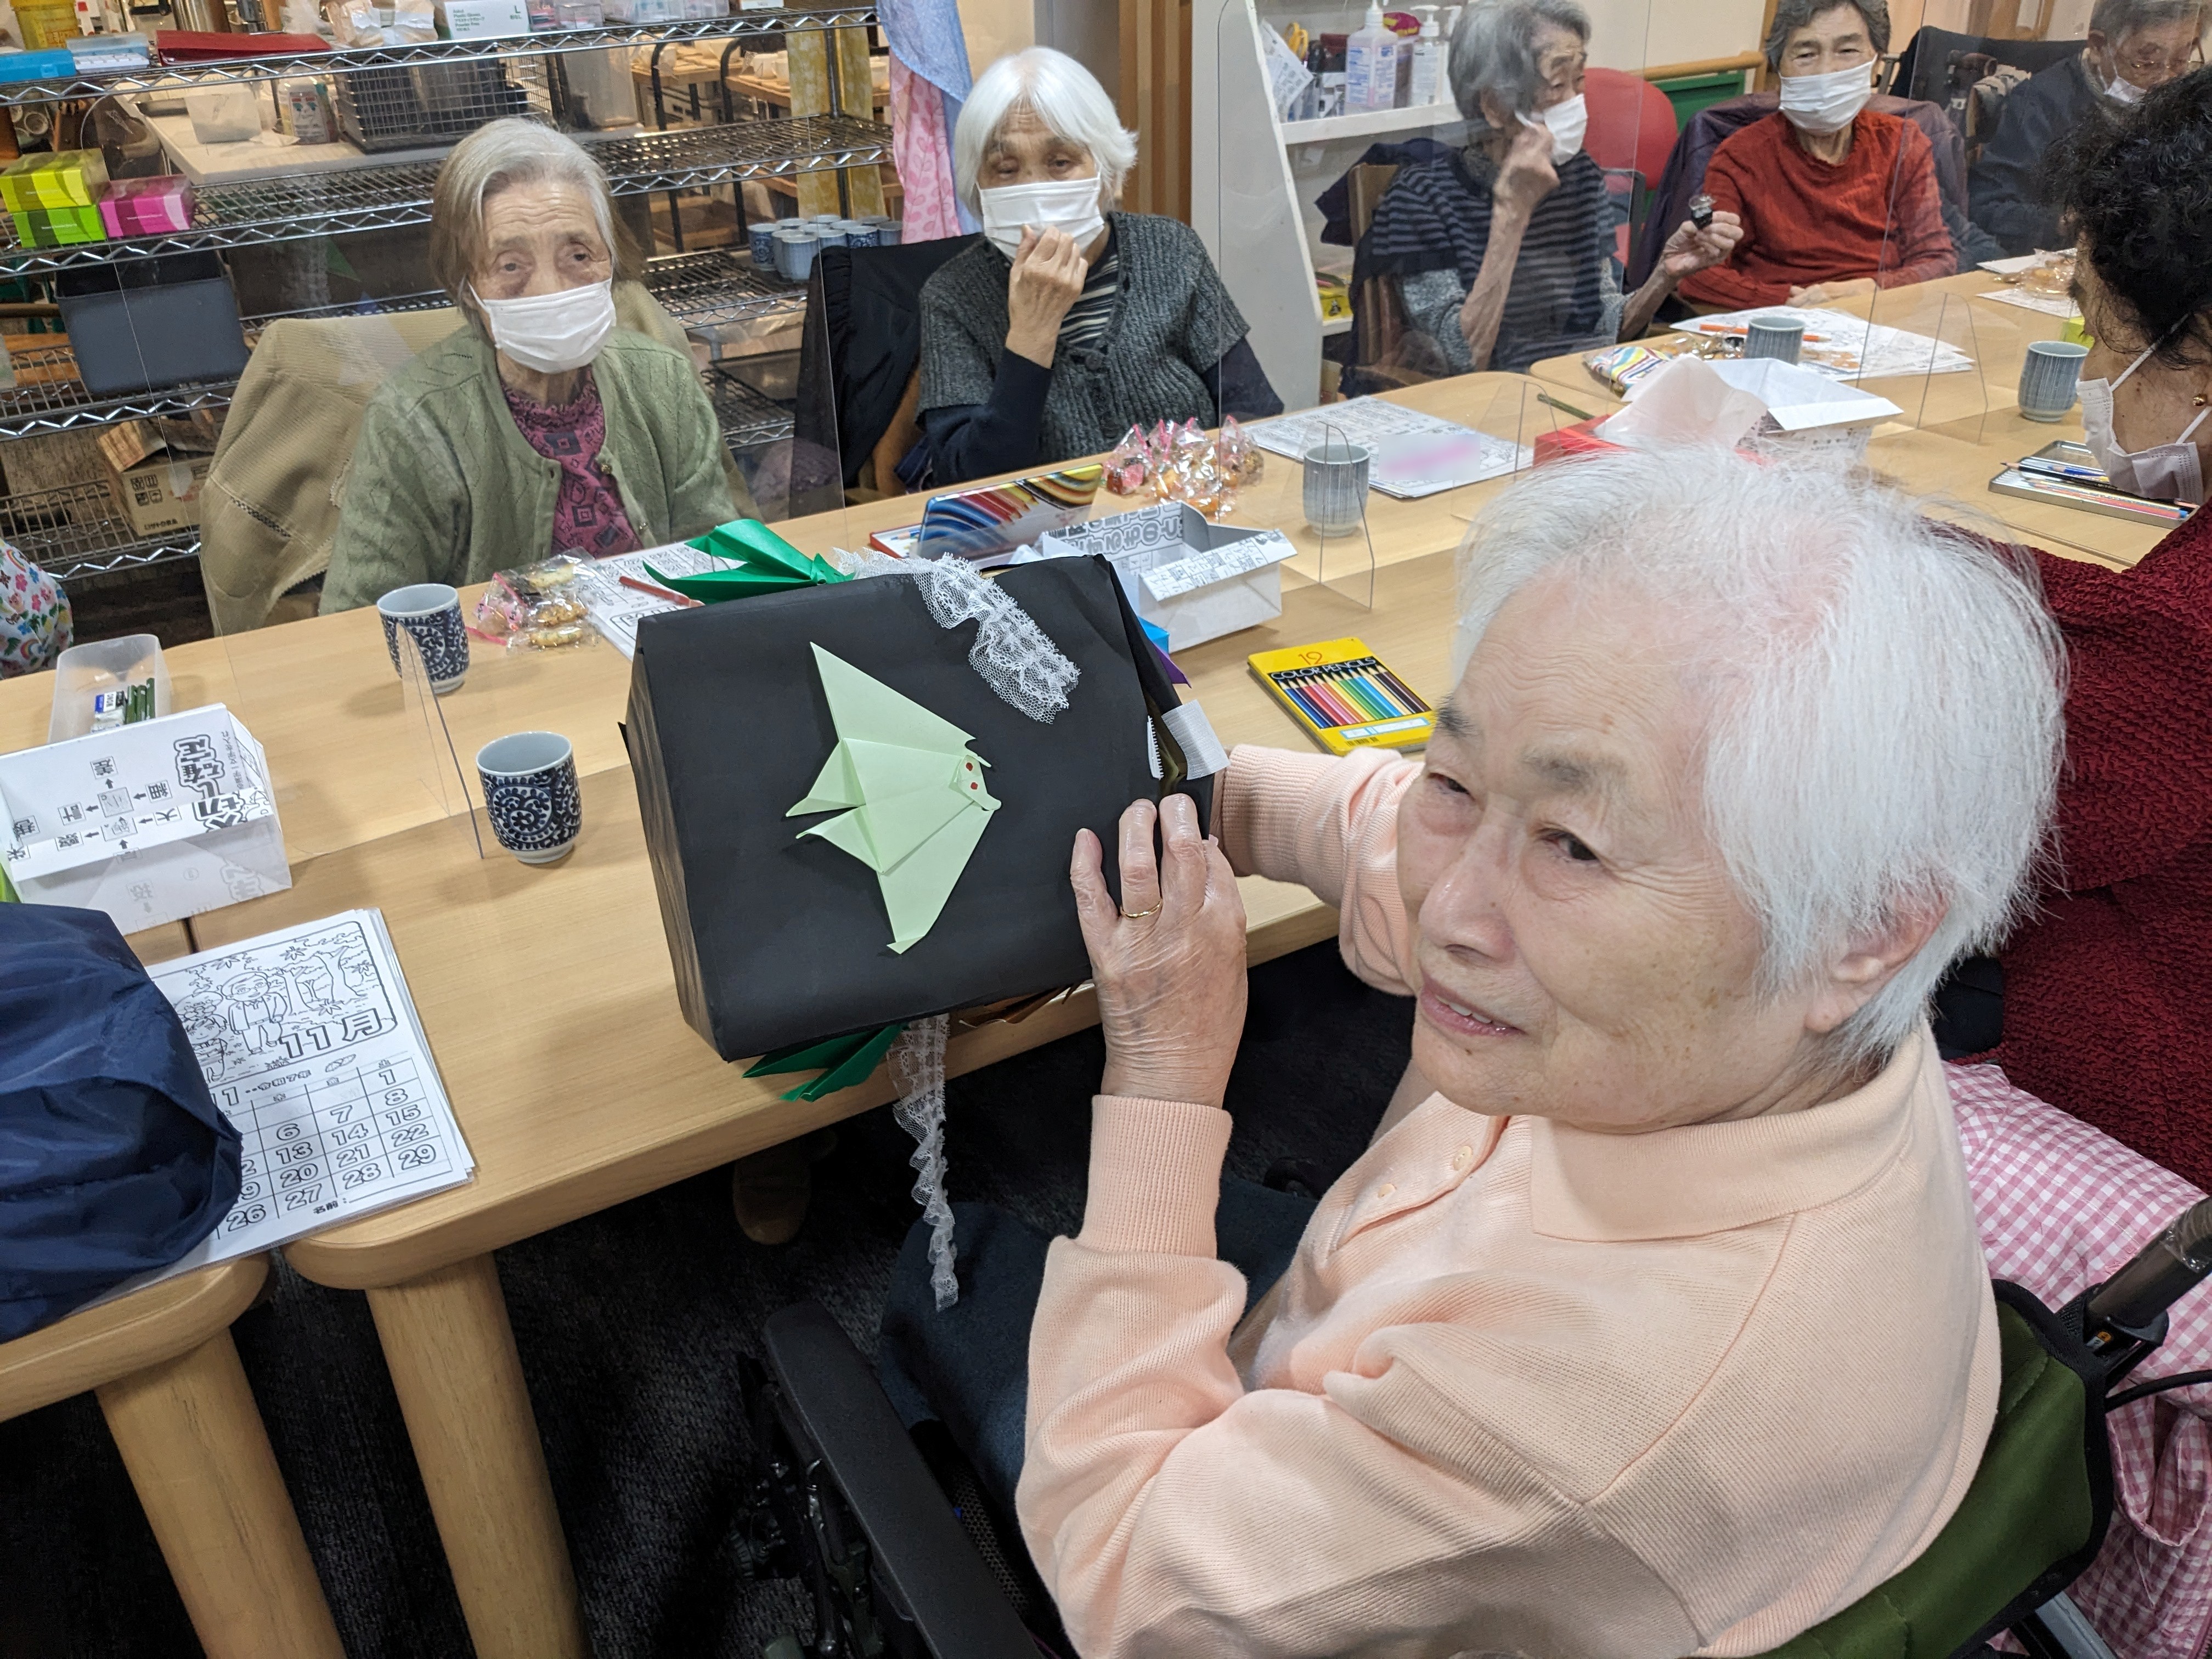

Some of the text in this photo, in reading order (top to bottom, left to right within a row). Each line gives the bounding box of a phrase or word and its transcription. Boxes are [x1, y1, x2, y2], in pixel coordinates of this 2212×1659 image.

[1271, 657, 1376, 680] COLOR PENCILS
[1298, 651, 1328, 665] 12
[278, 1007, 382, 1059] 11月
[379, 1069, 396, 1085] 1
[275, 1142, 313, 1164] 13
[331, 1122, 369, 1146] 14
[385, 1104, 421, 1126] 15
[276, 1088, 409, 1141] 6 7 8
[280, 1163, 318, 1188] 20
[336, 1143, 370, 1168] 21
[391, 1124, 430, 1147] 22
[226, 1144, 436, 1232] 26 27 28 29
